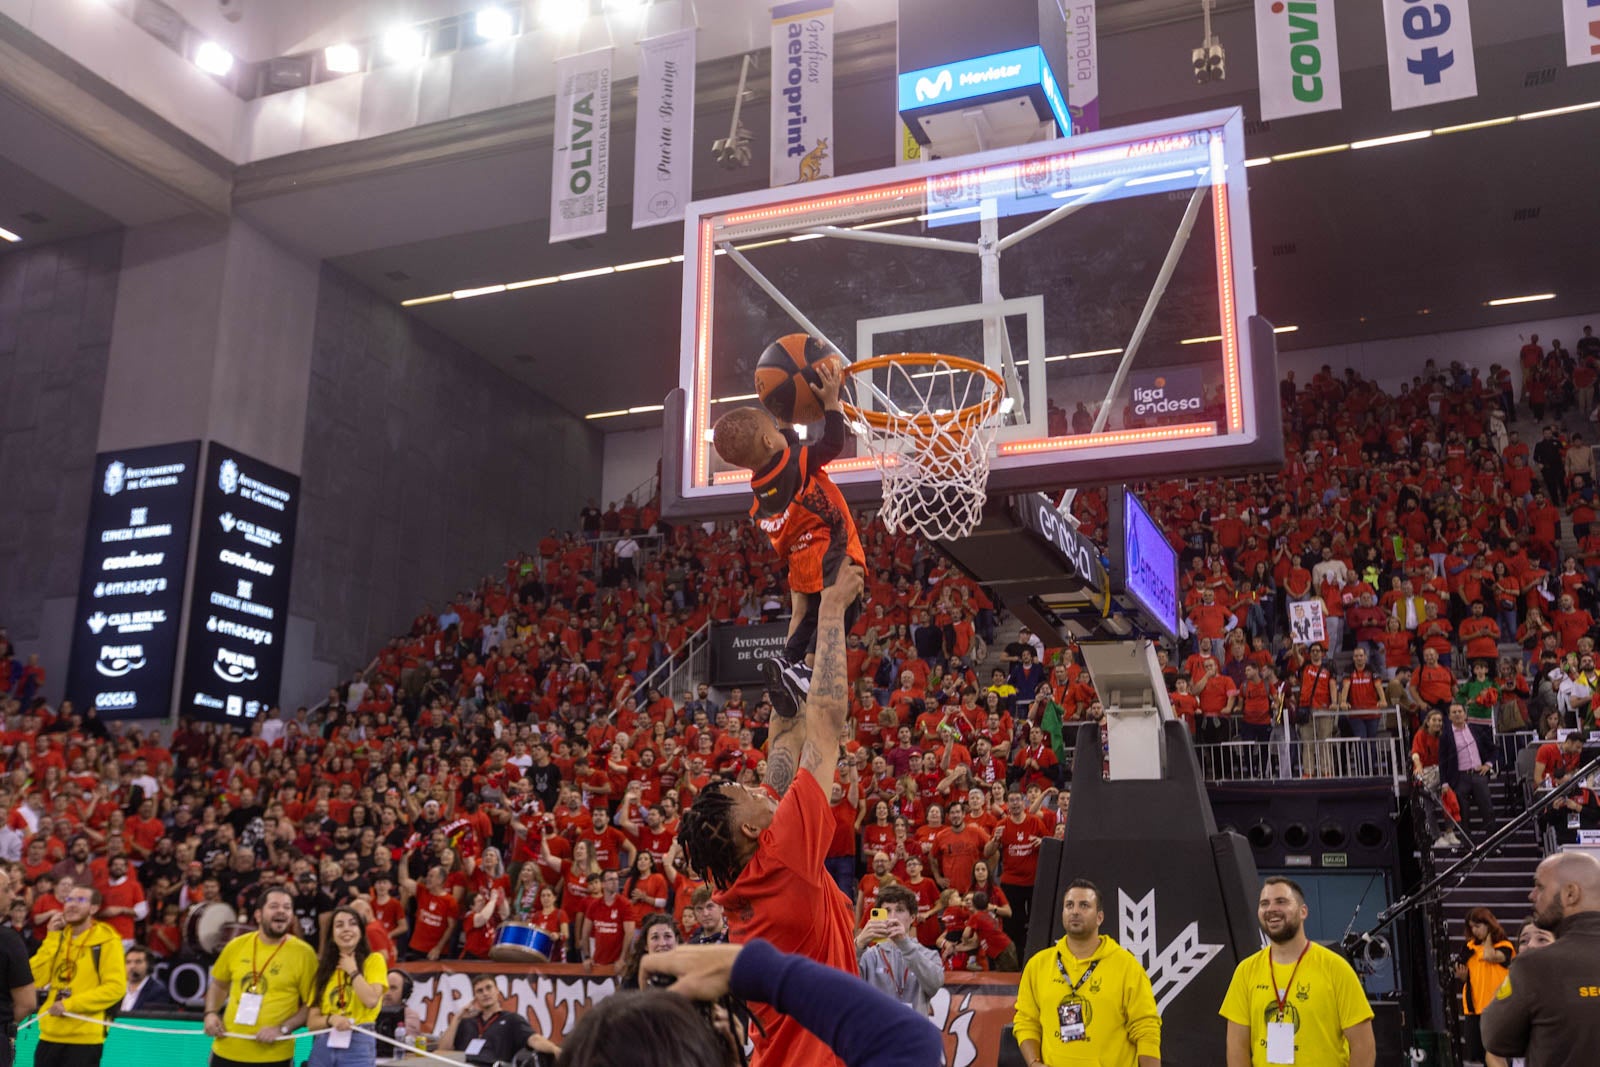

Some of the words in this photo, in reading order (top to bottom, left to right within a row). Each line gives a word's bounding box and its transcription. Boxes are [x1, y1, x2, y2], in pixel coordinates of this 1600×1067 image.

[804, 19, 828, 83] Gráficas
[1075, 3, 1092, 81] Farmacia
[1271, 0, 1324, 103] covi
[959, 64, 1022, 86] Movistar
[599, 67, 609, 111] HIERRO
[783, 23, 806, 158] aeroprint
[599, 113, 608, 129] EN
[570, 92, 594, 195] OLIVA
[596, 132, 608, 213] METALISTERÍA
[1134, 388, 1163, 402] liga
[1135, 397, 1200, 415] endesa
[105, 577, 167, 595] emasagra
[217, 619, 272, 645] emasagra
[738, 651, 751, 660] DE
[753, 647, 783, 659] GRAN
[1579, 986, 1600, 997] SE
